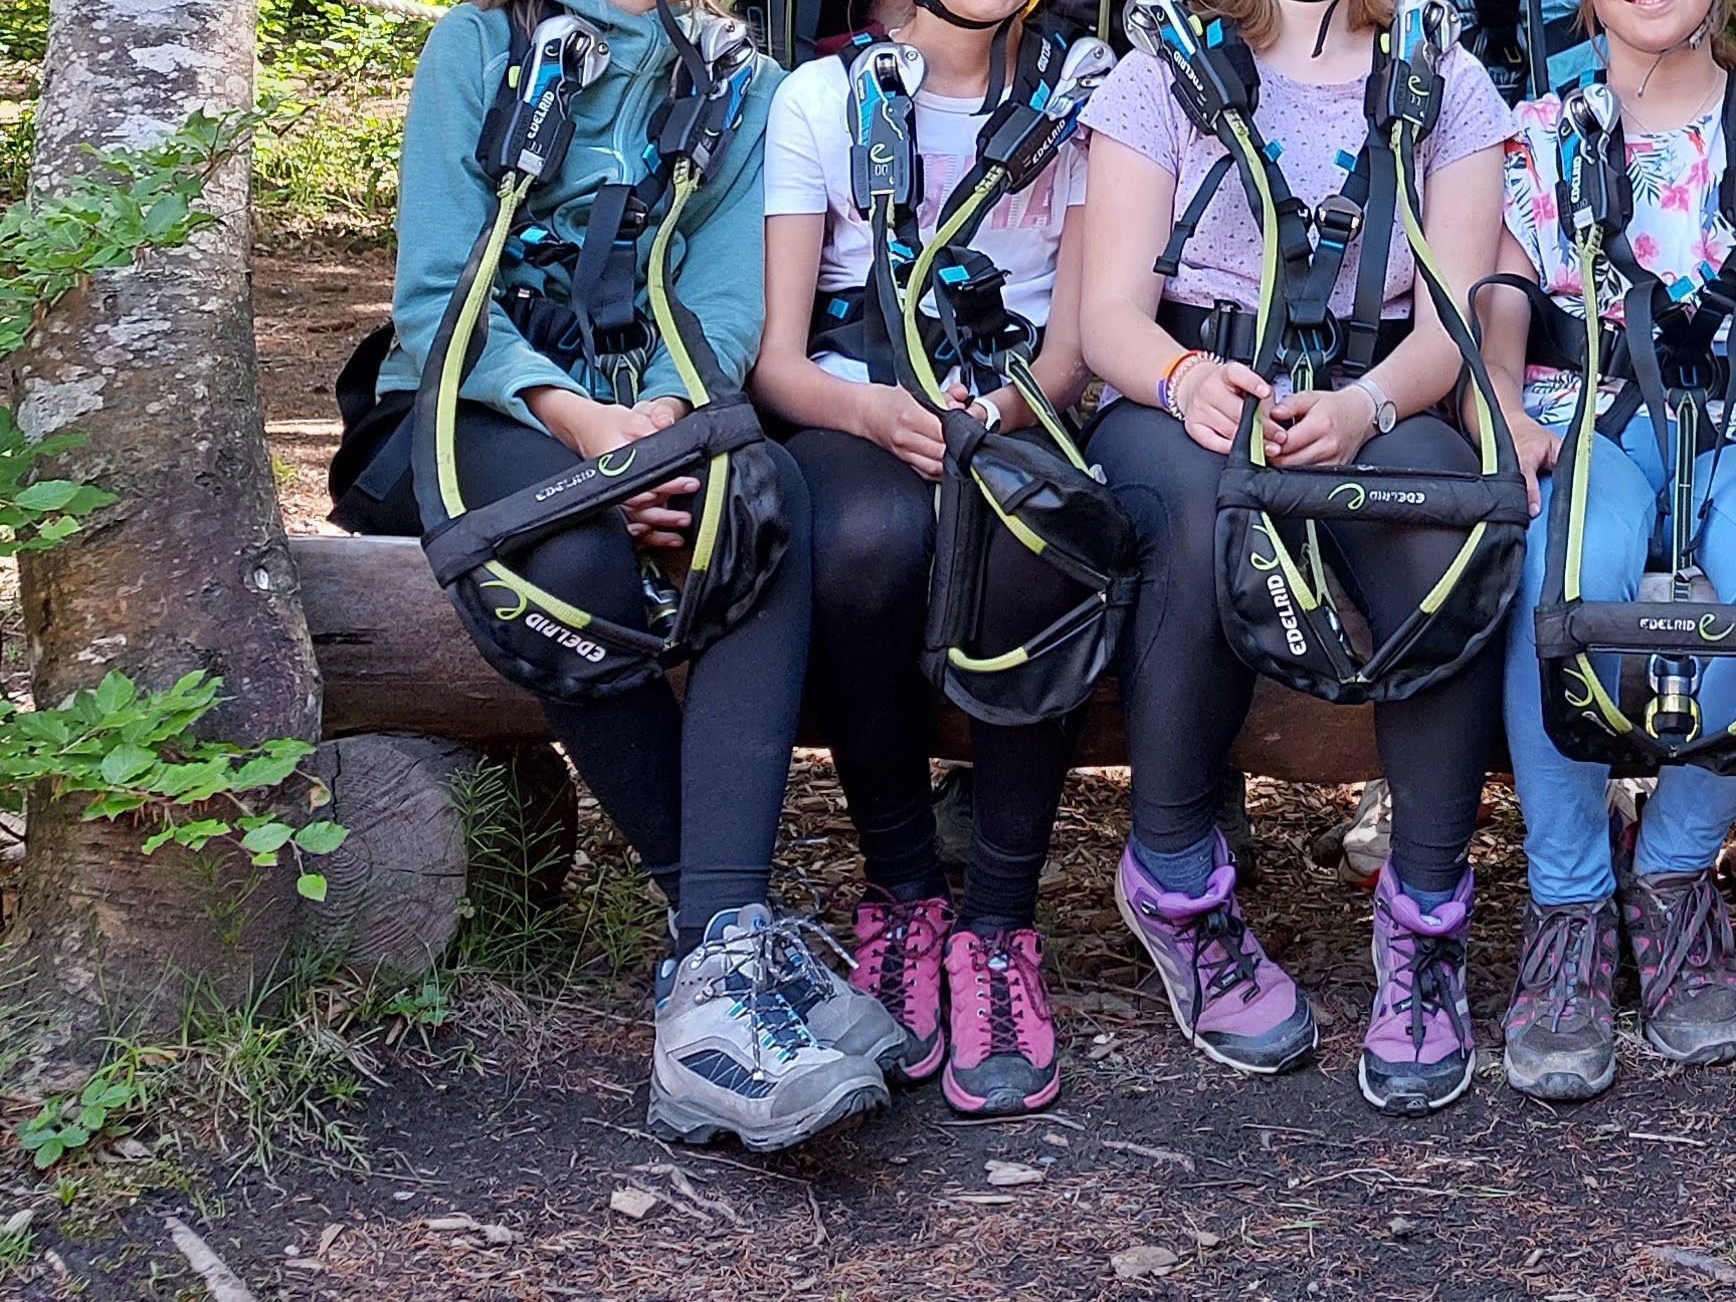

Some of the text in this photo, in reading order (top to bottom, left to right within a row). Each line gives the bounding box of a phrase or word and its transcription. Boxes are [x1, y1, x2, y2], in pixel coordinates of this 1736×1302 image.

[526, 90, 555, 139] EDELRID
[1032, 118, 1066, 165] EDELRID
[534, 469, 597, 501] EDELRID
[1368, 490, 1426, 505] EDELRID
[524, 612, 607, 663] EDELRID
[1266, 574, 1307, 656] EDELRID
[1639, 617, 1696, 633] EDELRID
